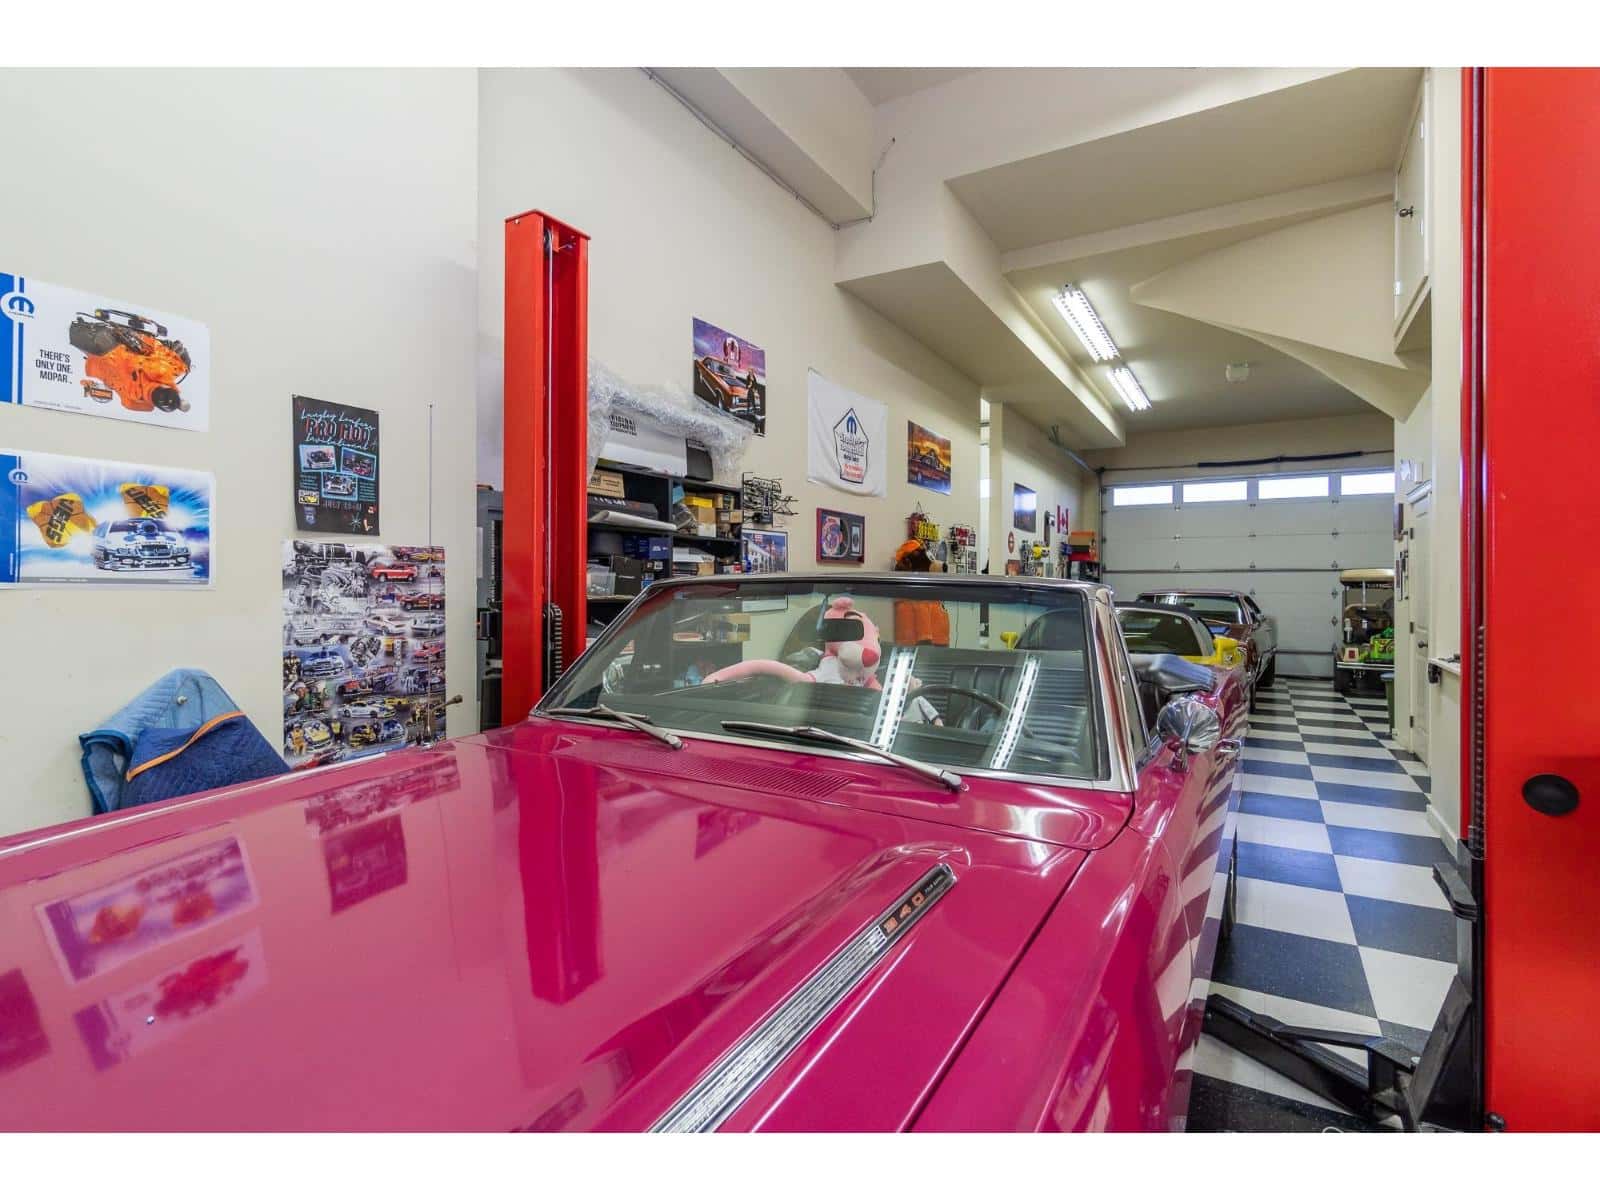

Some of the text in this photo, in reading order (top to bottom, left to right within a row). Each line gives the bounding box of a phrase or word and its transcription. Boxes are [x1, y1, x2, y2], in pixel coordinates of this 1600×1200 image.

[35, 359, 55, 370] ONLY
[40, 349, 71, 363] THERE'S
[304, 417, 371, 443] PRO MOD
[883, 891, 925, 934] 340
